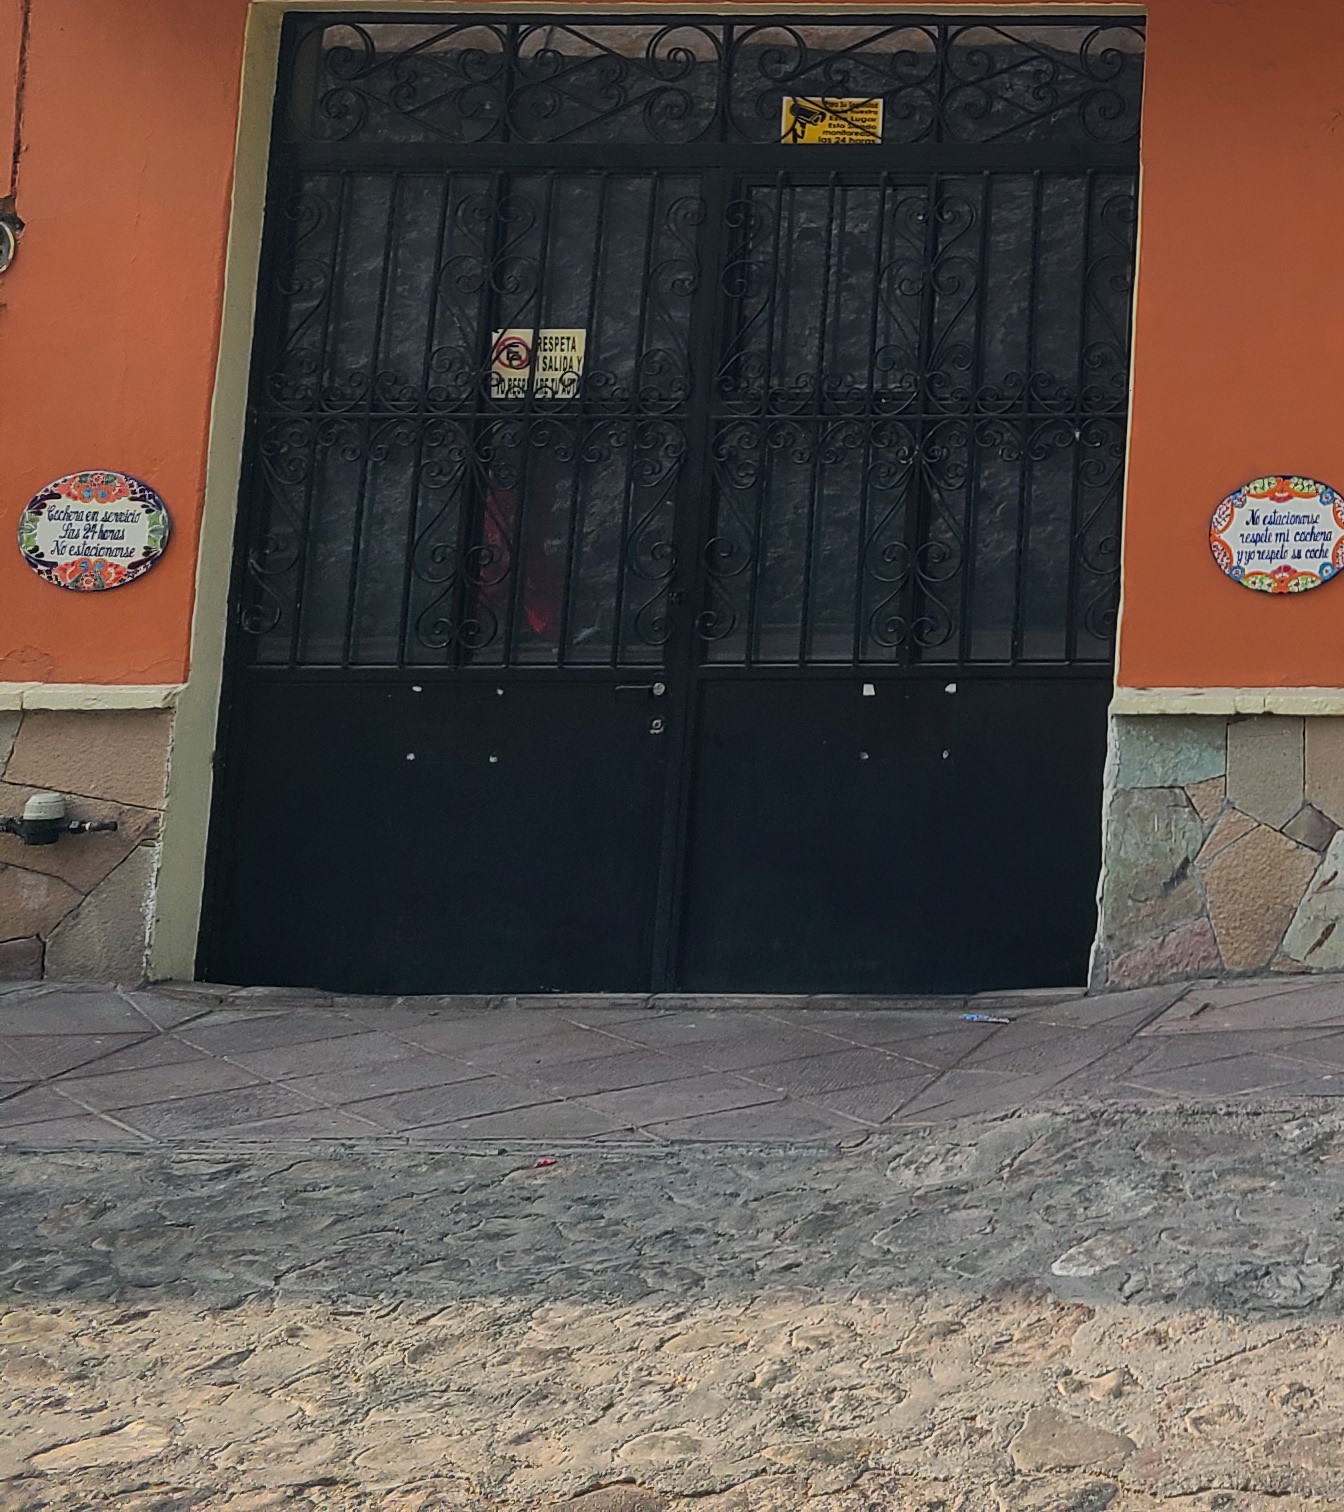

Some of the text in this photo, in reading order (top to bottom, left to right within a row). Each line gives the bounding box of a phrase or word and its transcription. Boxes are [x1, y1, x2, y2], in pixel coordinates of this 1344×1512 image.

[542, 355, 574, 372] SALIDA
[577, 356, 583, 372] Y
[86, 510, 99, 522] en
[1246, 509, 1320, 526] No estacionarse
[82, 523, 97, 540] 24
[98, 524, 125, 541] horas
[1240, 526, 1332, 546] respete mi cochera
[50, 540, 67, 556] No
[1257, 544, 1288, 564] respeto
[1291, 548, 1302, 559] su
[1305, 543, 1329, 559] coche
